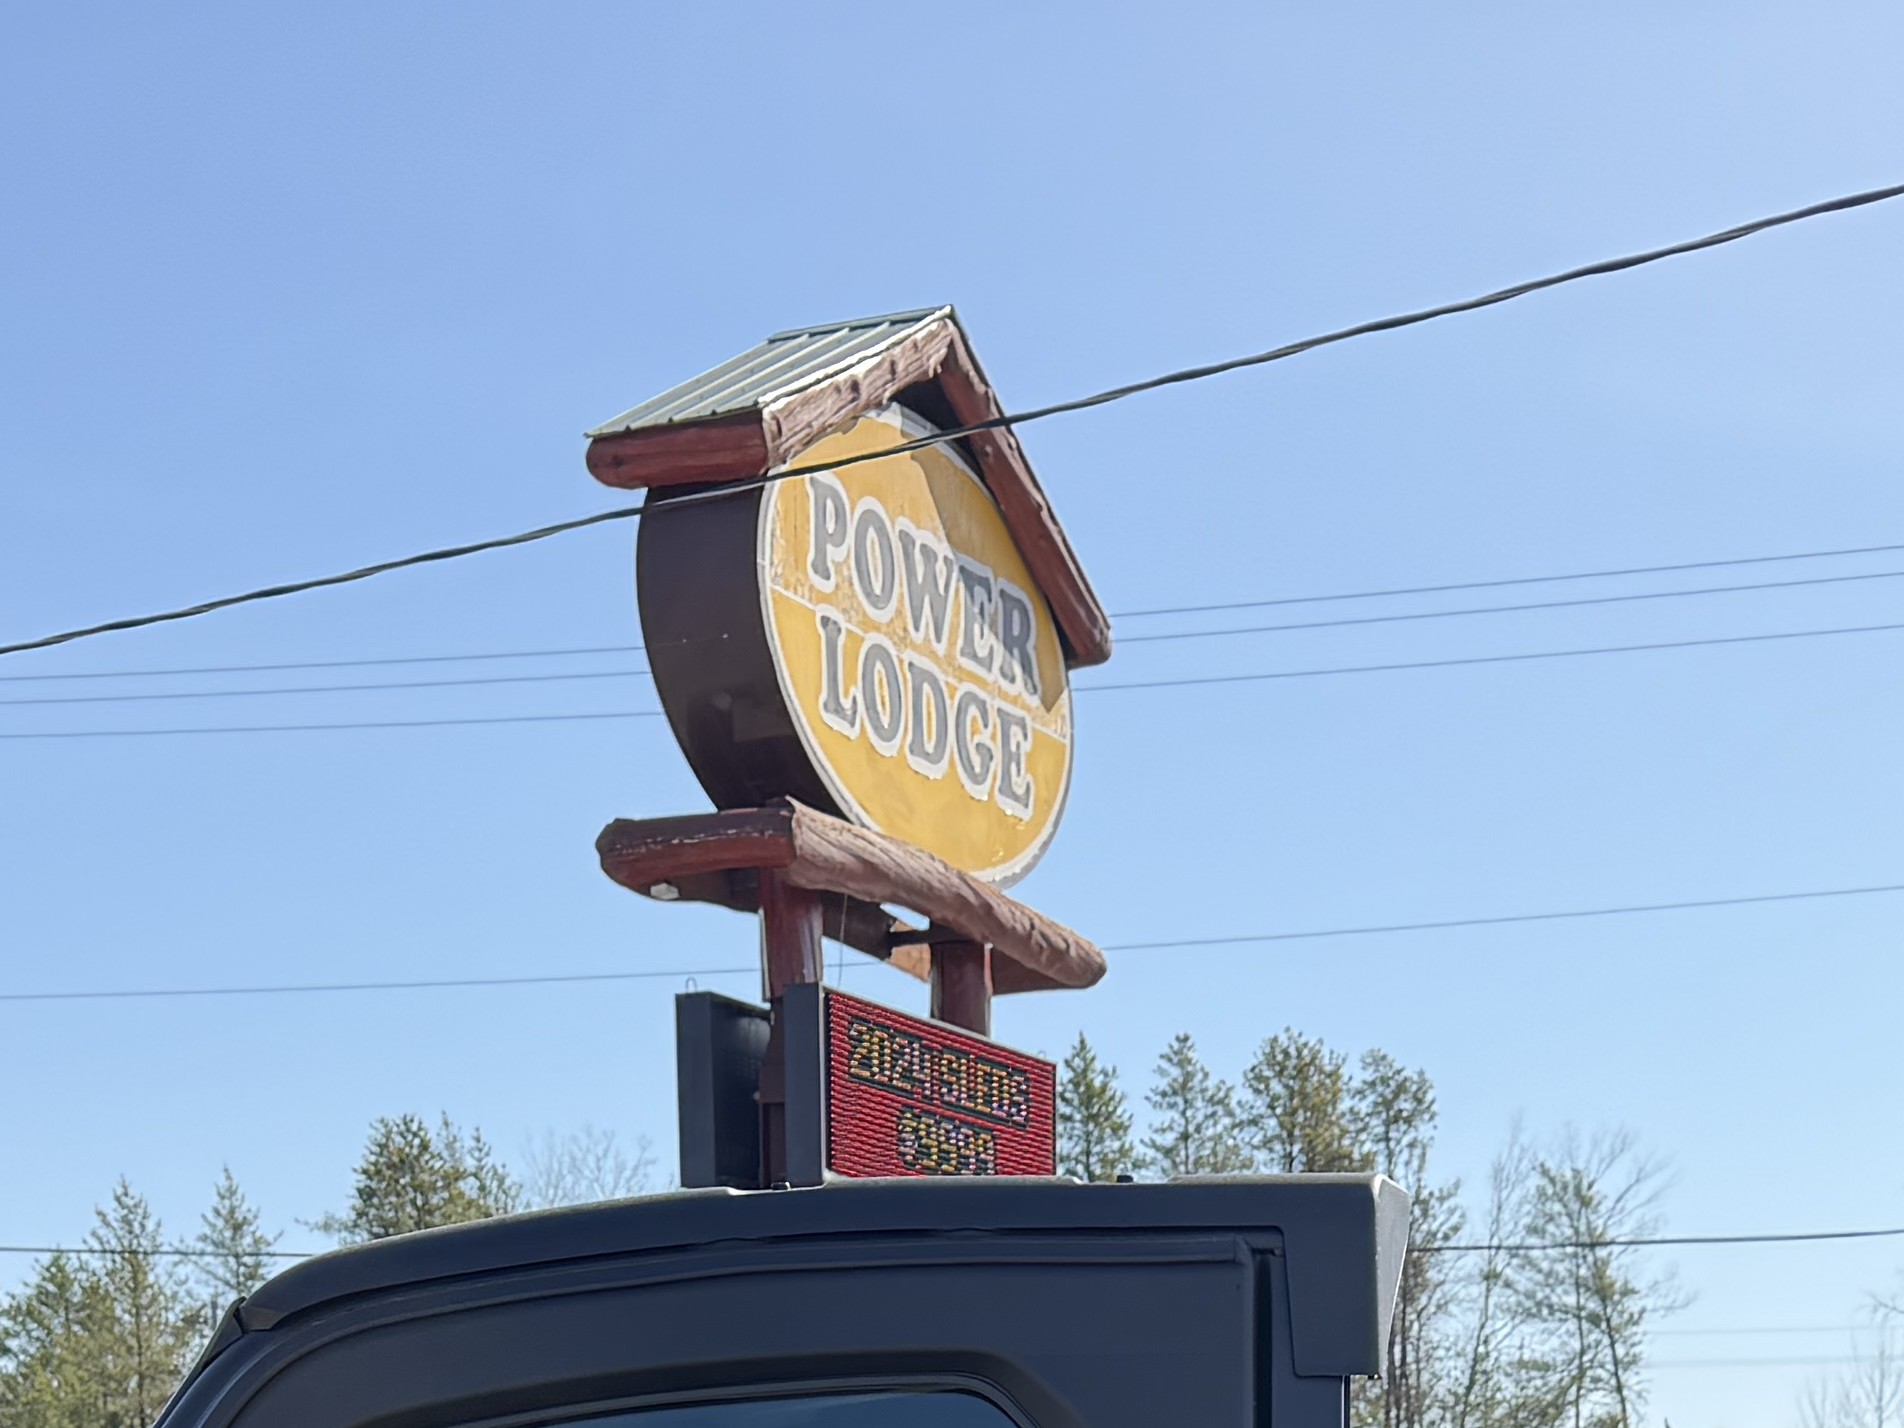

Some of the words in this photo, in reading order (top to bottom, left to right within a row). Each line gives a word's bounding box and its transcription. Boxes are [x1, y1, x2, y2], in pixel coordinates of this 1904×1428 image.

[808, 471, 1039, 700] POWER
[817, 607, 1032, 816] LODGE
[849, 1022, 931, 1097] 2024
[940, 1051, 1027, 1124] SLEDS
